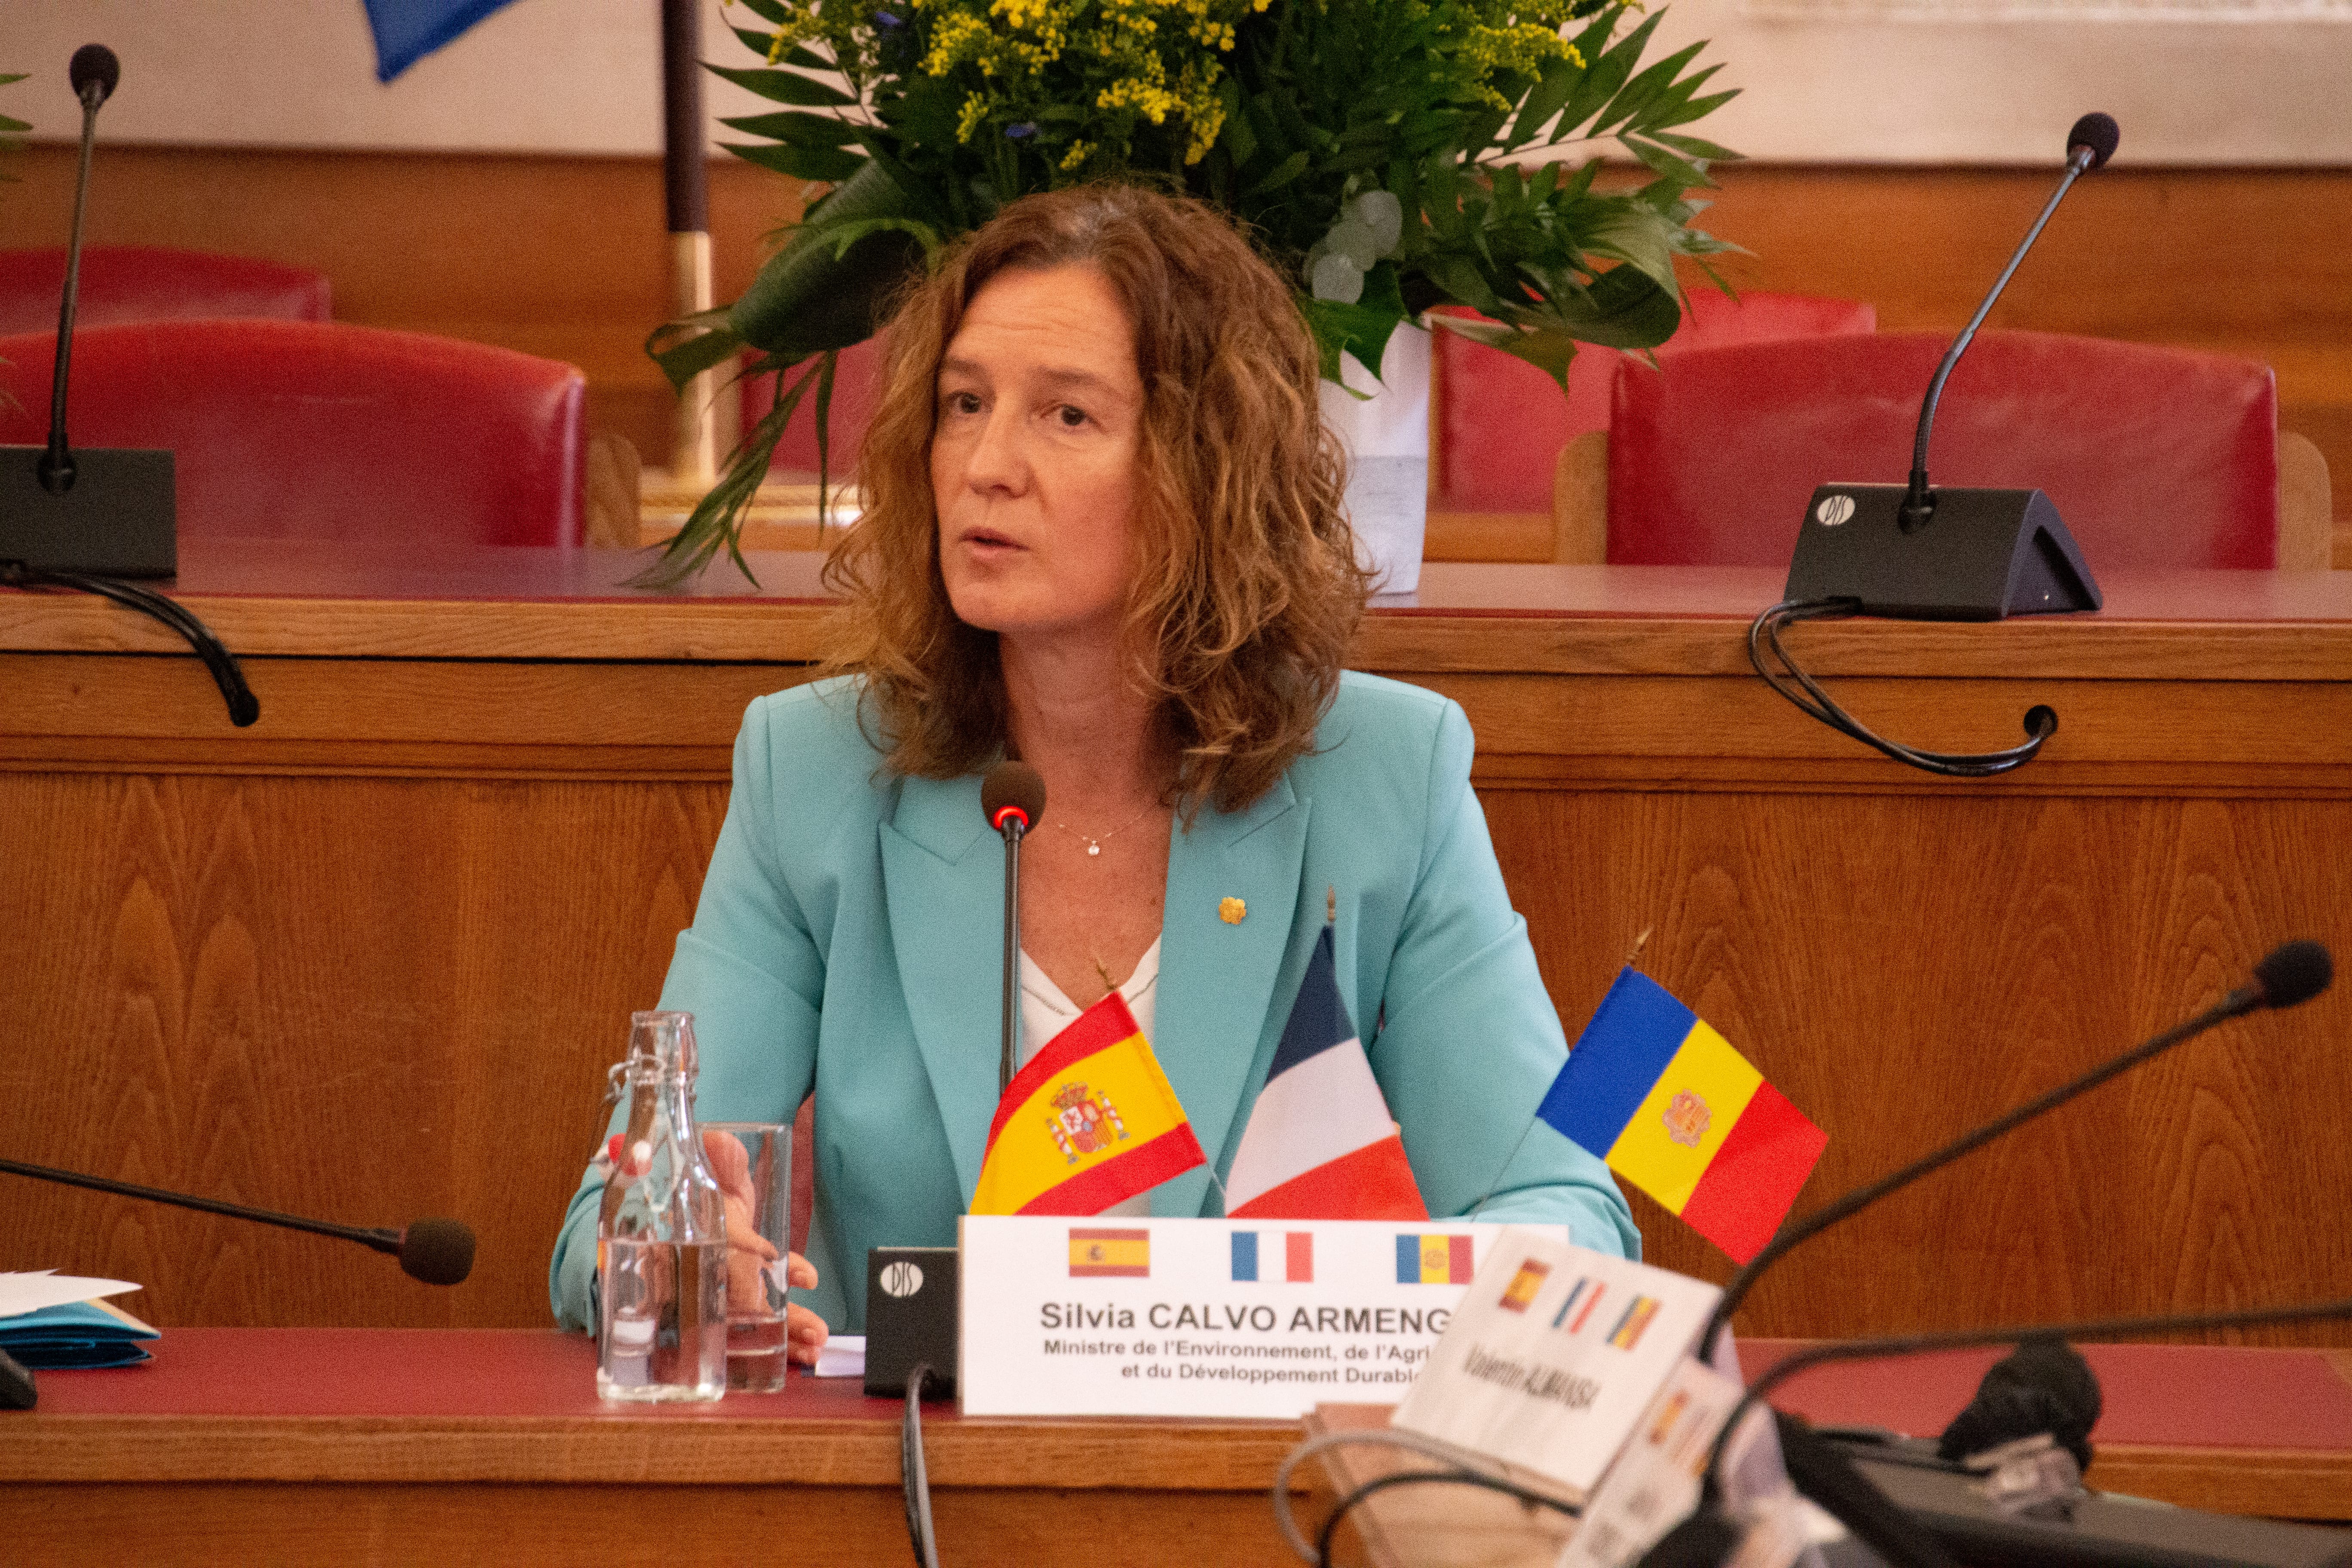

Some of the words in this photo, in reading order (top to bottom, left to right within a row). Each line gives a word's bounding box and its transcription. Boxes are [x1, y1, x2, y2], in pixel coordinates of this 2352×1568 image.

[1040, 1302, 1135, 1329] Silvia
[1148, 1303, 1277, 1332] CALVO
[1044, 1339, 1125, 1354] Ministre
[1133, 1341, 1156, 1355] de
[1164, 1340, 1338, 1361] l'Environnement,
[1344, 1346, 1368, 1360] de
[1121, 1364, 1139, 1377] et
[1146, 1364, 1172, 1378] du
[1179, 1363, 1338, 1384] Développement
